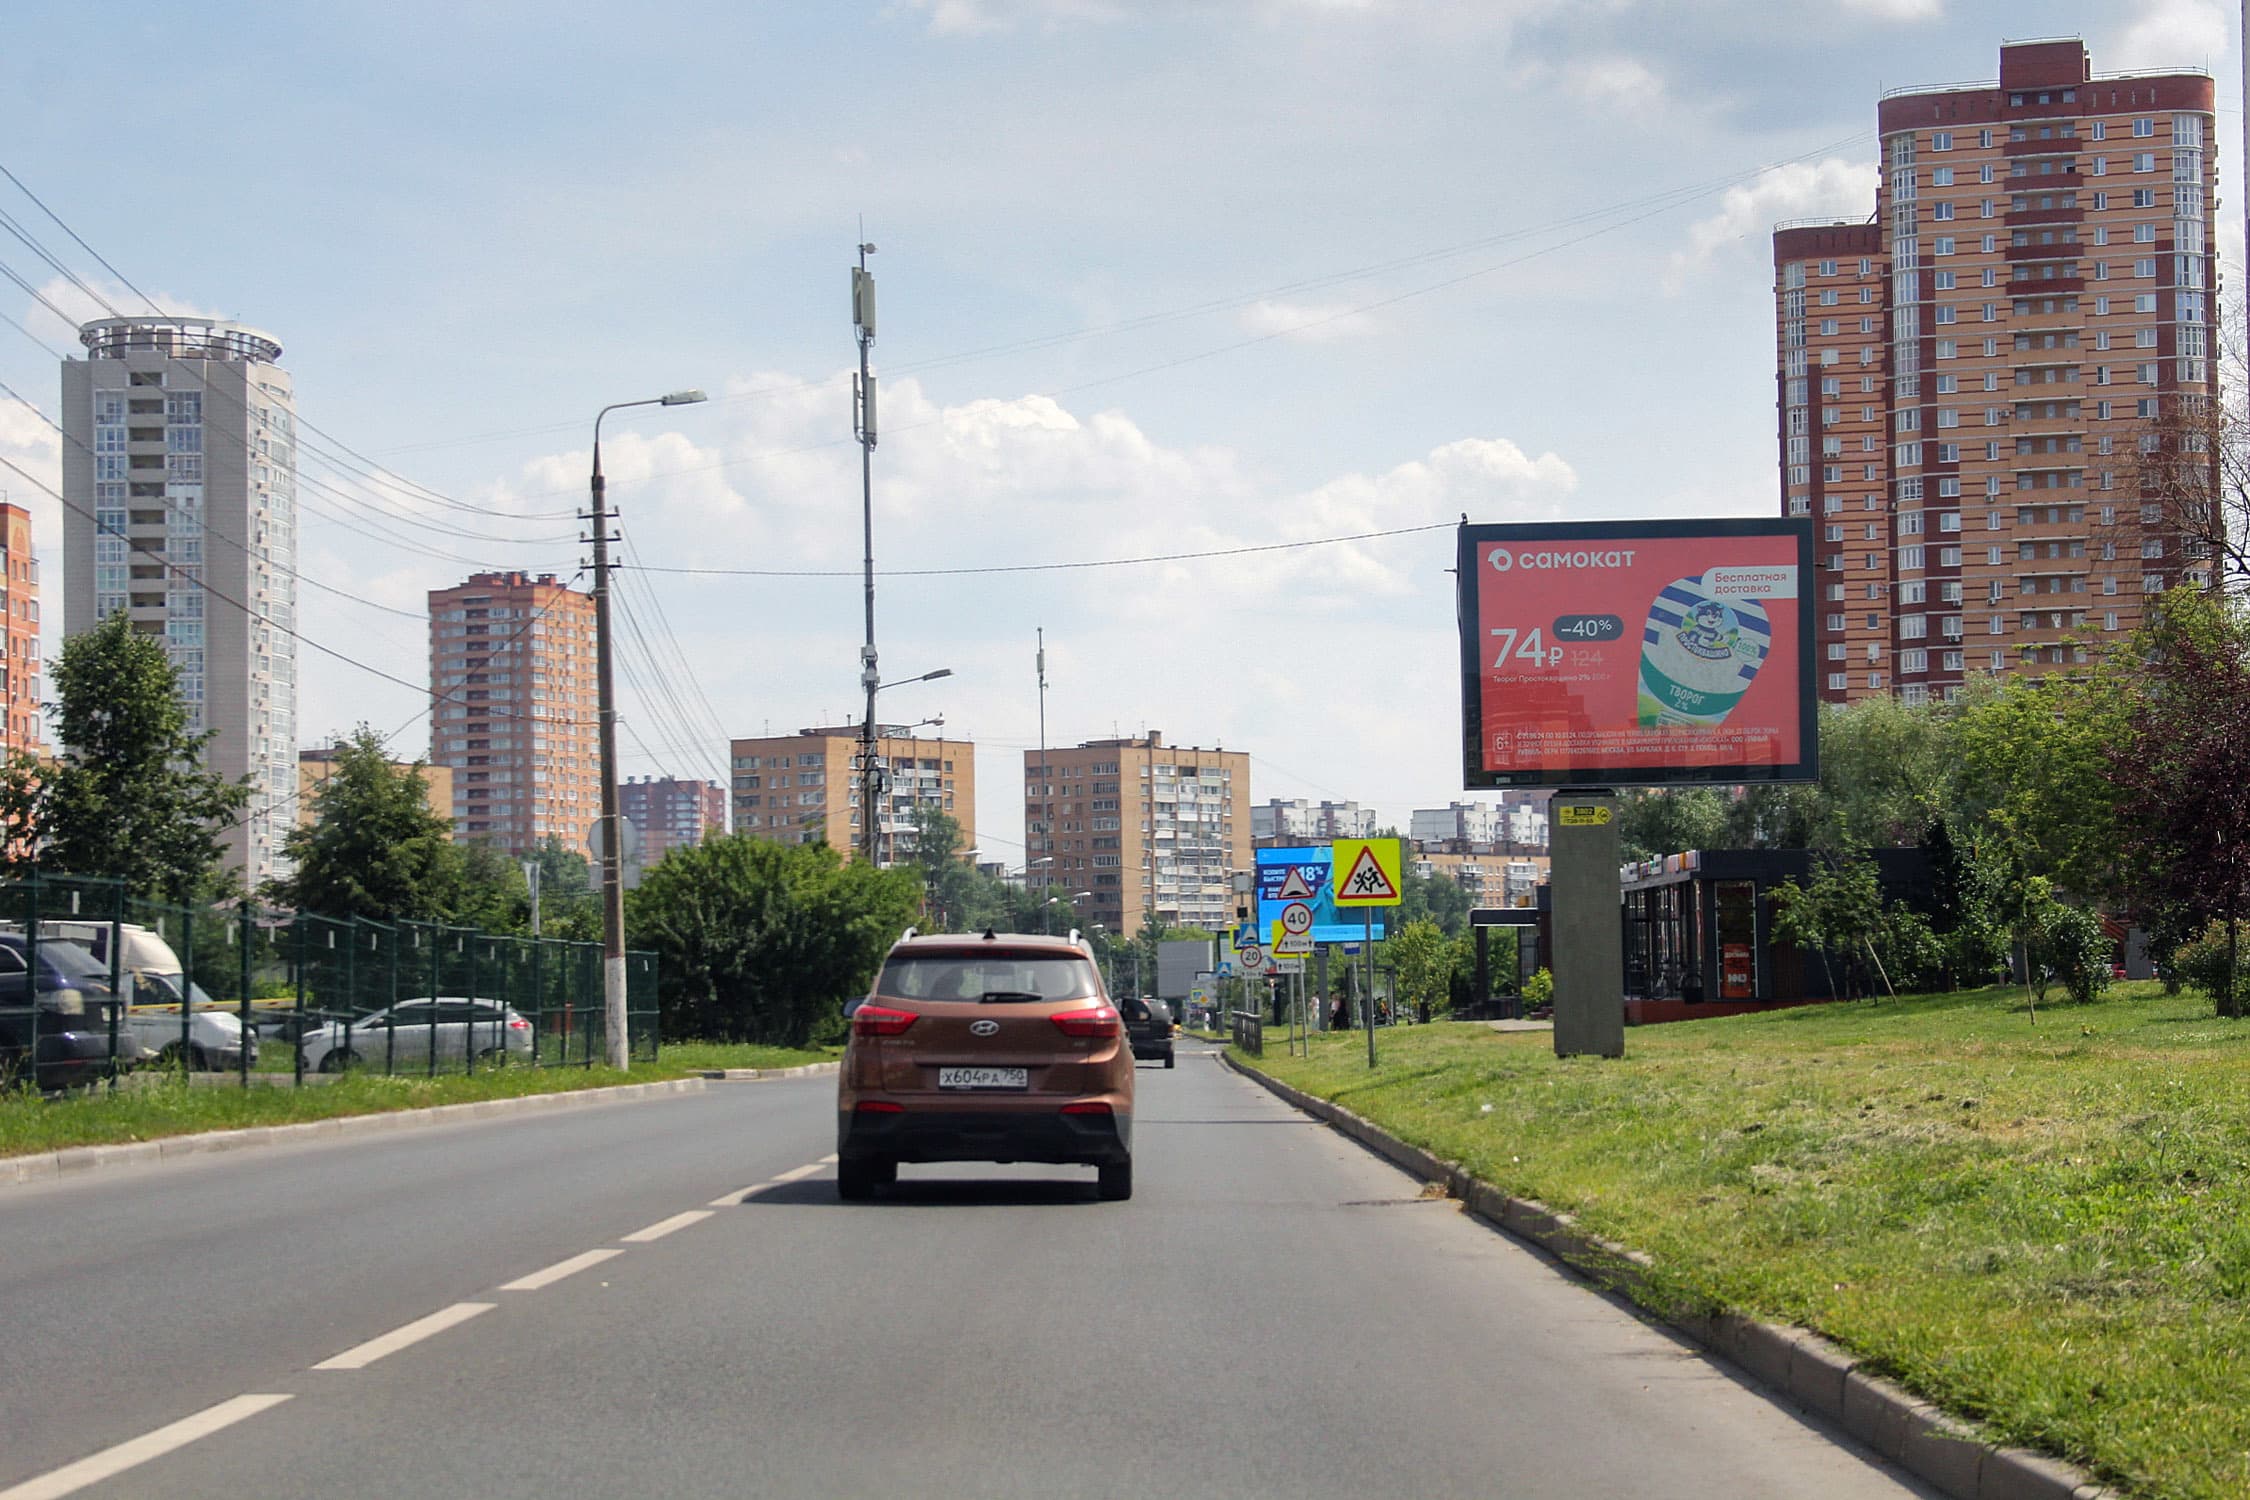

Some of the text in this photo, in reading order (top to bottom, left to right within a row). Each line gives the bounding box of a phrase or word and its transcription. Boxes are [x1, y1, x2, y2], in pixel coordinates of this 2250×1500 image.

[1714, 571, 1787, 584] Бесплатная
[1714, 583, 1772, 595] доставка
[1571, 649, 1604, 667] 124
[1669, 684, 1705, 705] ТВОРОГ
[1674, 698, 1689, 711] 2%
[1496, 736, 1510, 750] 6+
[1287, 911, 1307, 924] 40
[1245, 951, 1258, 961] 20
[1003, 1068, 1024, 1081] 750
